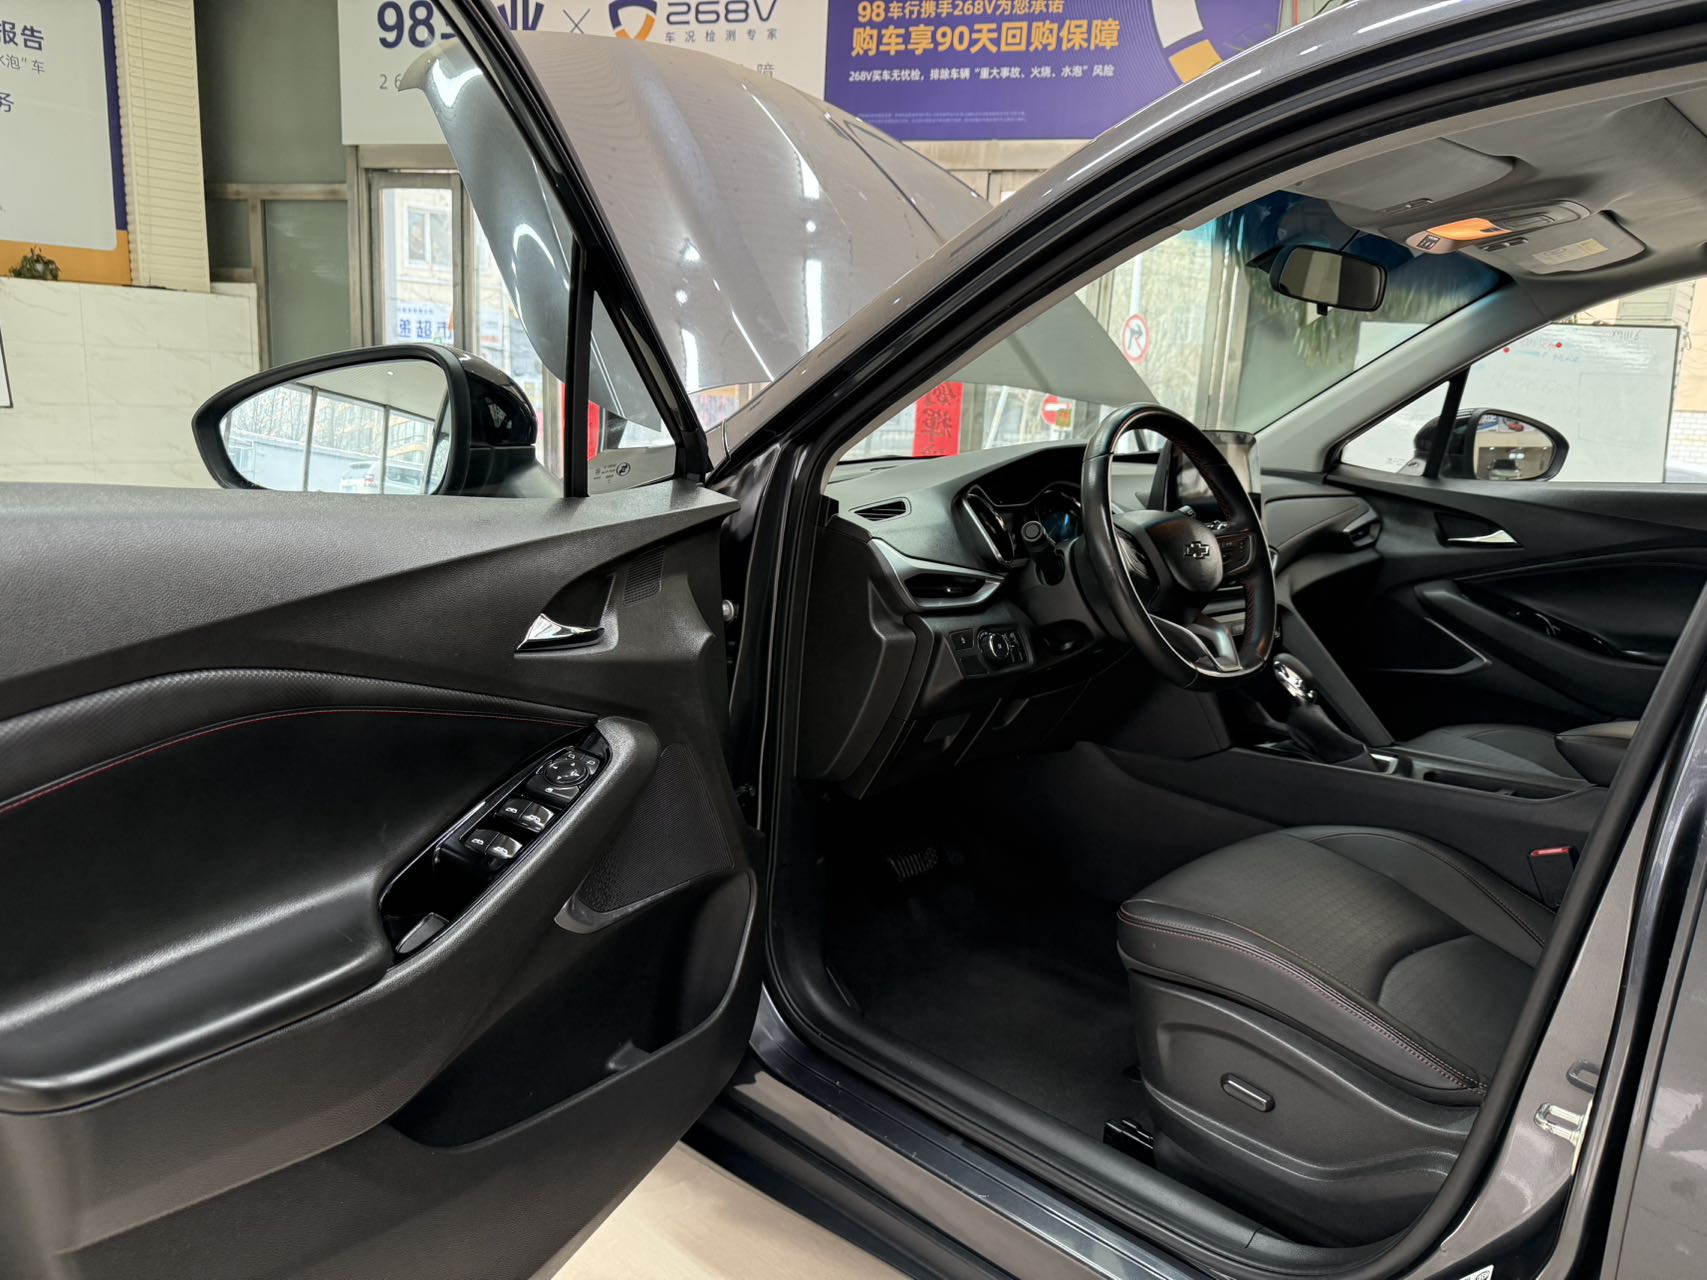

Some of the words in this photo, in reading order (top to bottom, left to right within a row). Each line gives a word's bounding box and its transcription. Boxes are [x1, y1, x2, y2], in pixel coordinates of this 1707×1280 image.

[666, 0, 777, 25] 268V
[665, 27, 778, 43] 车况检测专家
[850, 18, 1120, 57] 购车享90天回购保障
